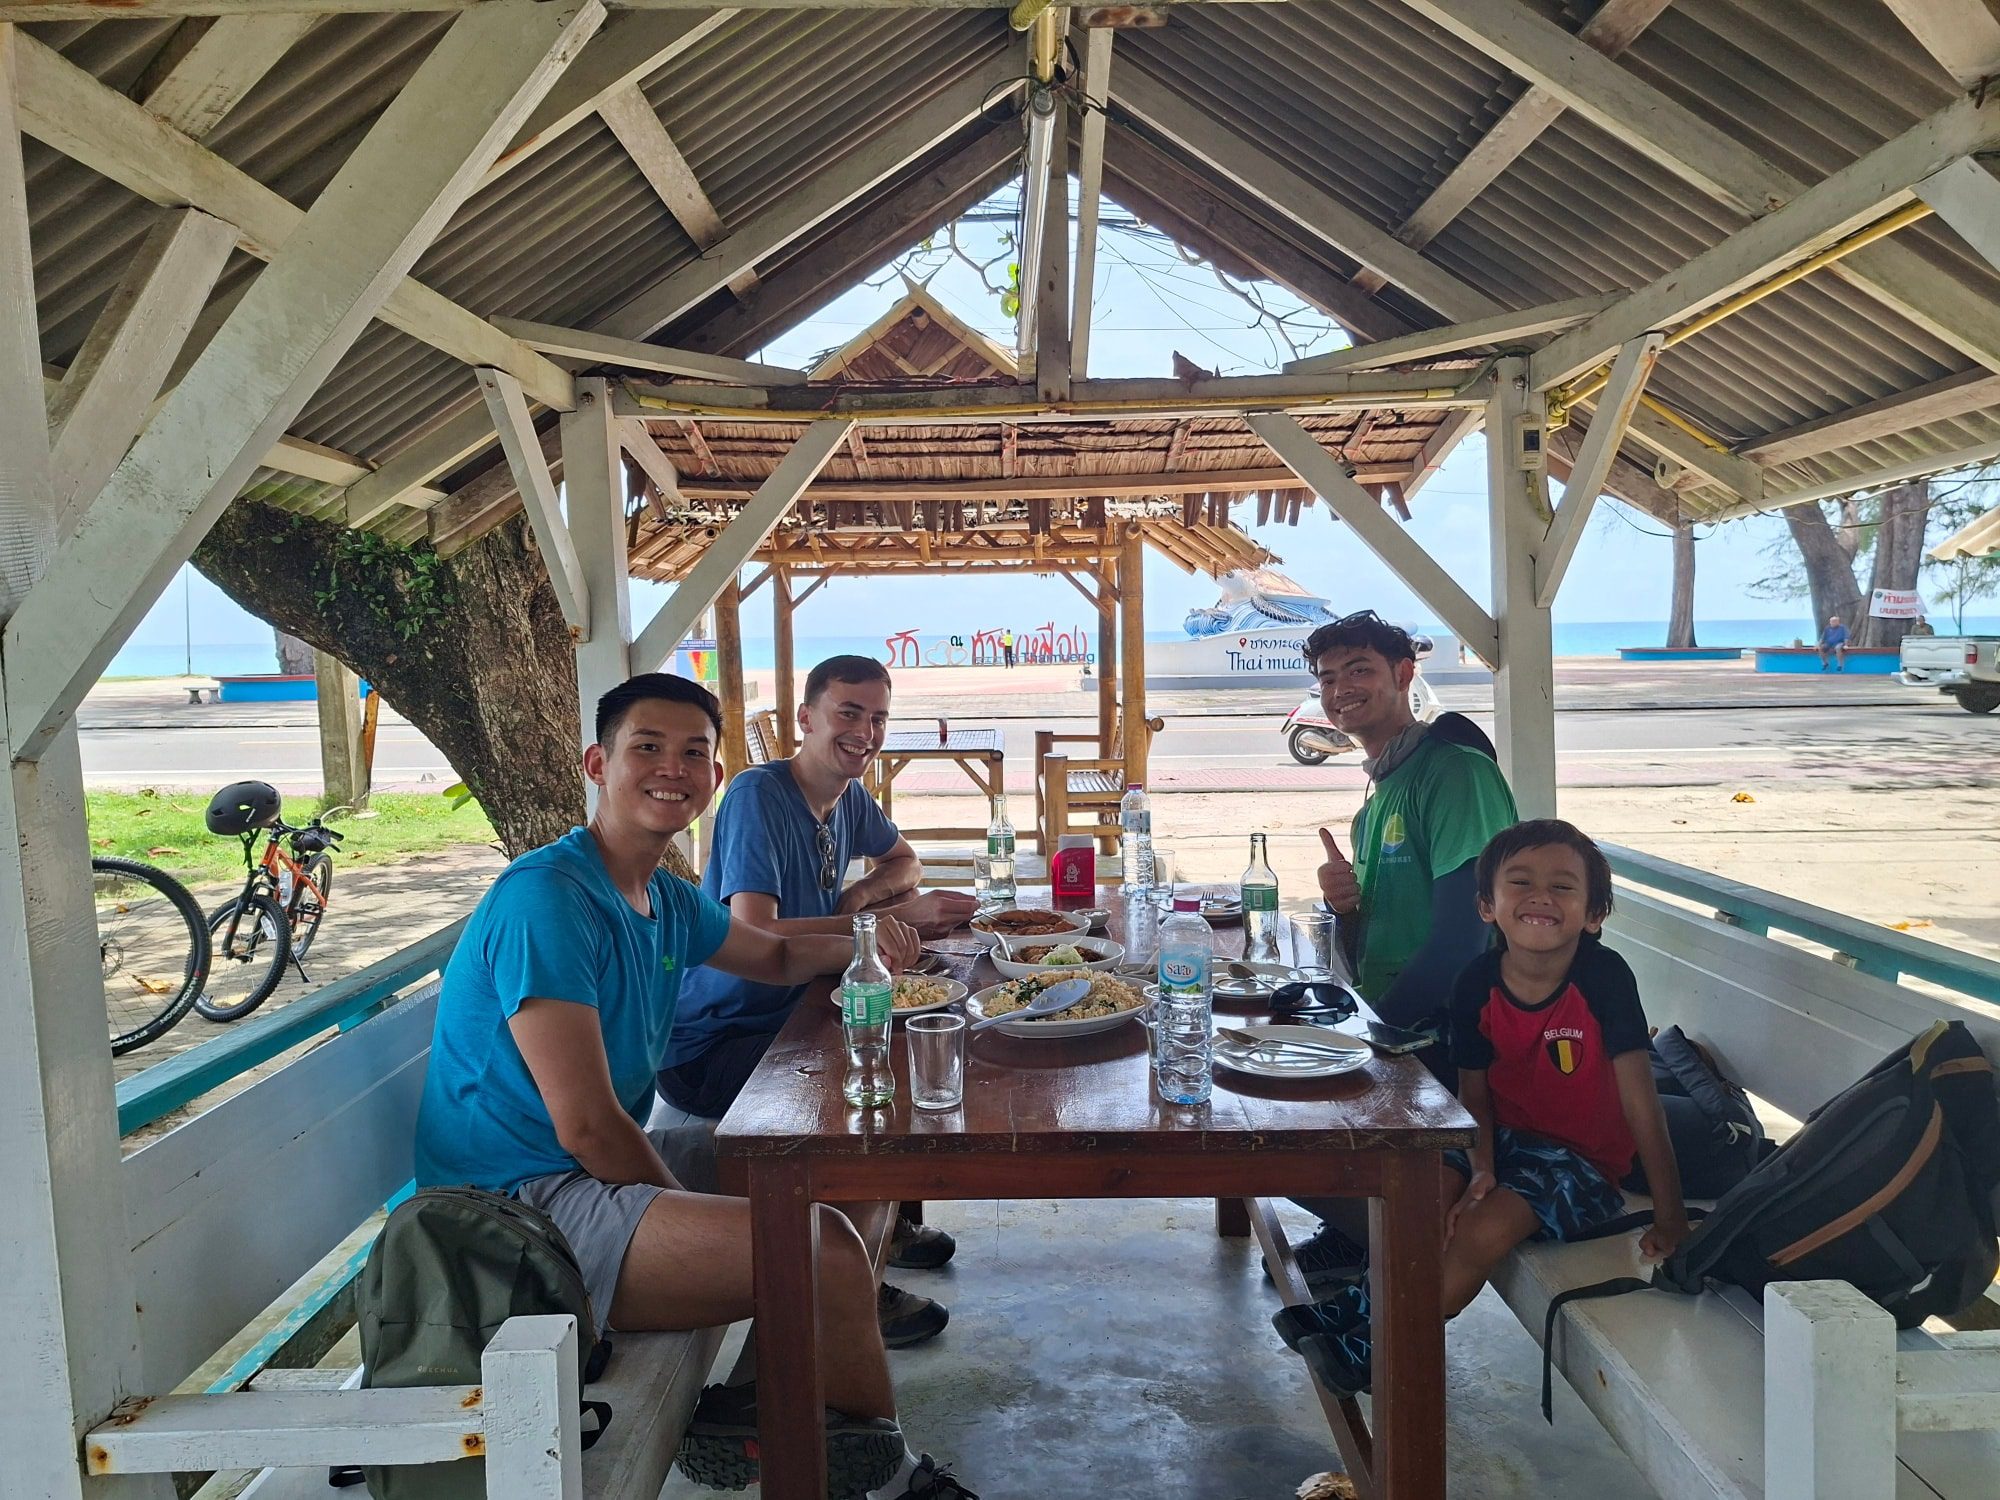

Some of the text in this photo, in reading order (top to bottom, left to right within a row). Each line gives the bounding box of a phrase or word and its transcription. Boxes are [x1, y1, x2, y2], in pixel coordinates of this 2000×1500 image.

[1226, 650, 1262, 671] Thai
[160, 977, 198, 1025] HUTCHINSON
[111, 1030, 148, 1048] PYTHO
[1543, 1027, 1583, 1040] BELGIUM
